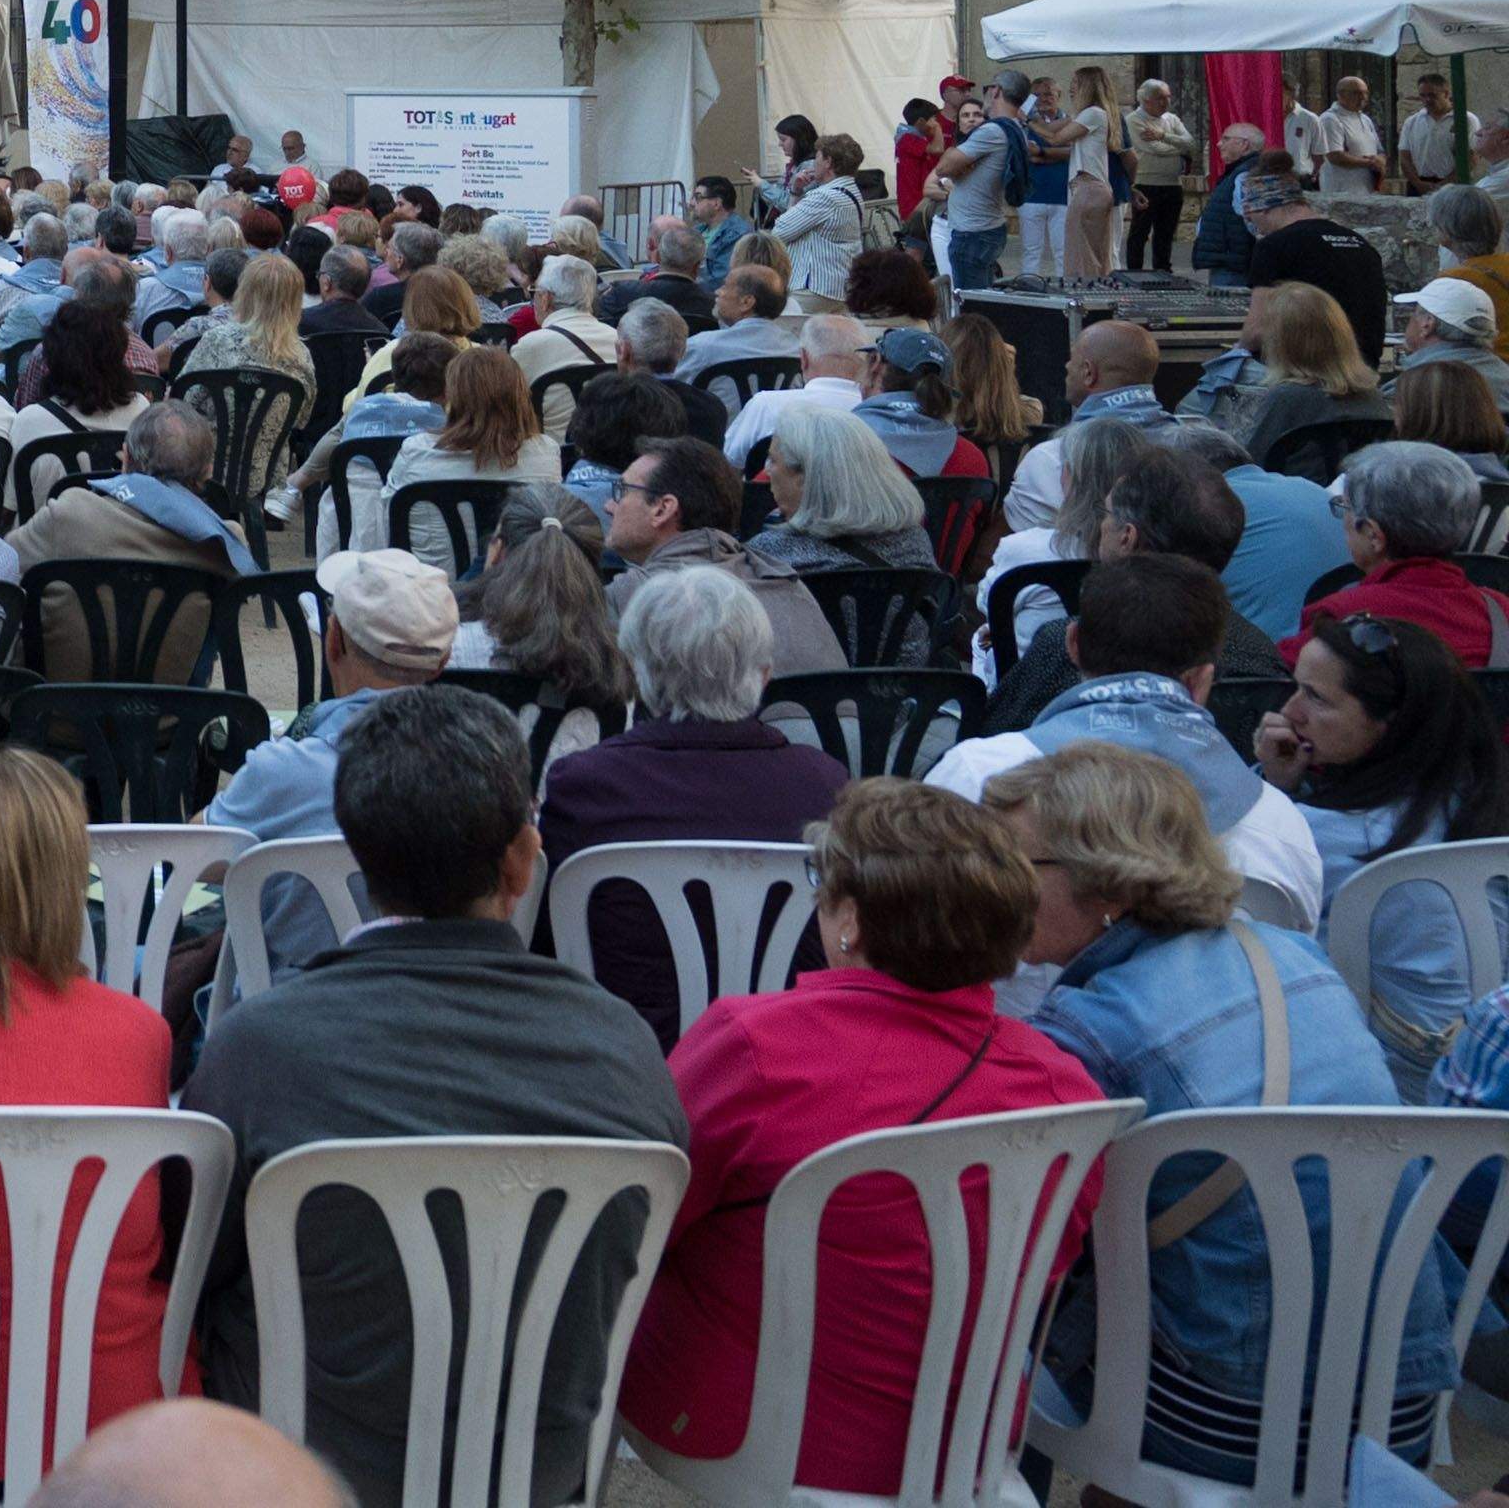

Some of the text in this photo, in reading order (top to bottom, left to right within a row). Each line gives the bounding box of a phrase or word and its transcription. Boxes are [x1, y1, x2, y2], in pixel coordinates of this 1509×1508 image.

[403, 110, 436, 124] TOT
[461, 149, 480, 158] Port
[462, 189, 504, 198] Activitats
